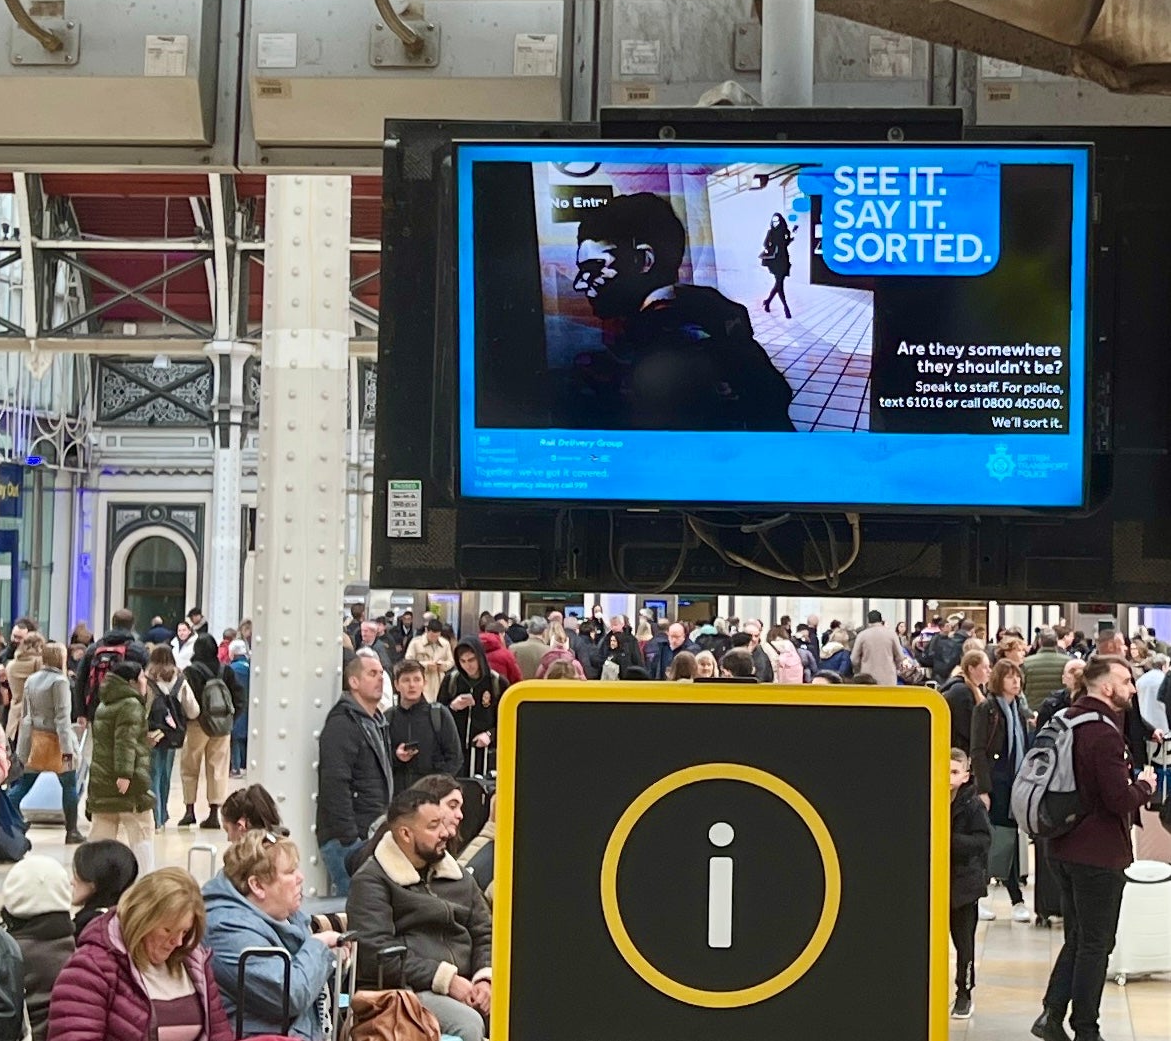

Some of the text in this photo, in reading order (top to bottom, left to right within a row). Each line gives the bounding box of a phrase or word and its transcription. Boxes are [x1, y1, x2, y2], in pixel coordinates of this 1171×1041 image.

[833, 166, 947, 196] SEE IT.
[573, 196, 608, 208] Entr
[833, 200, 946, 229] SAY IT.
[833, 233, 992, 263] SORTED.
[897, 341, 1061, 359] Are they somewhere
[917, 360, 953, 376] they
[1035, 361, 1063, 374] be?
[915, 381, 1064, 395] Speak to staff. For police,
[879, 397, 1063, 409] text 61016 or call 0800 405040.
[1023, 418, 1048, 428] sort
[1050, 418, 1062, 428] it.
